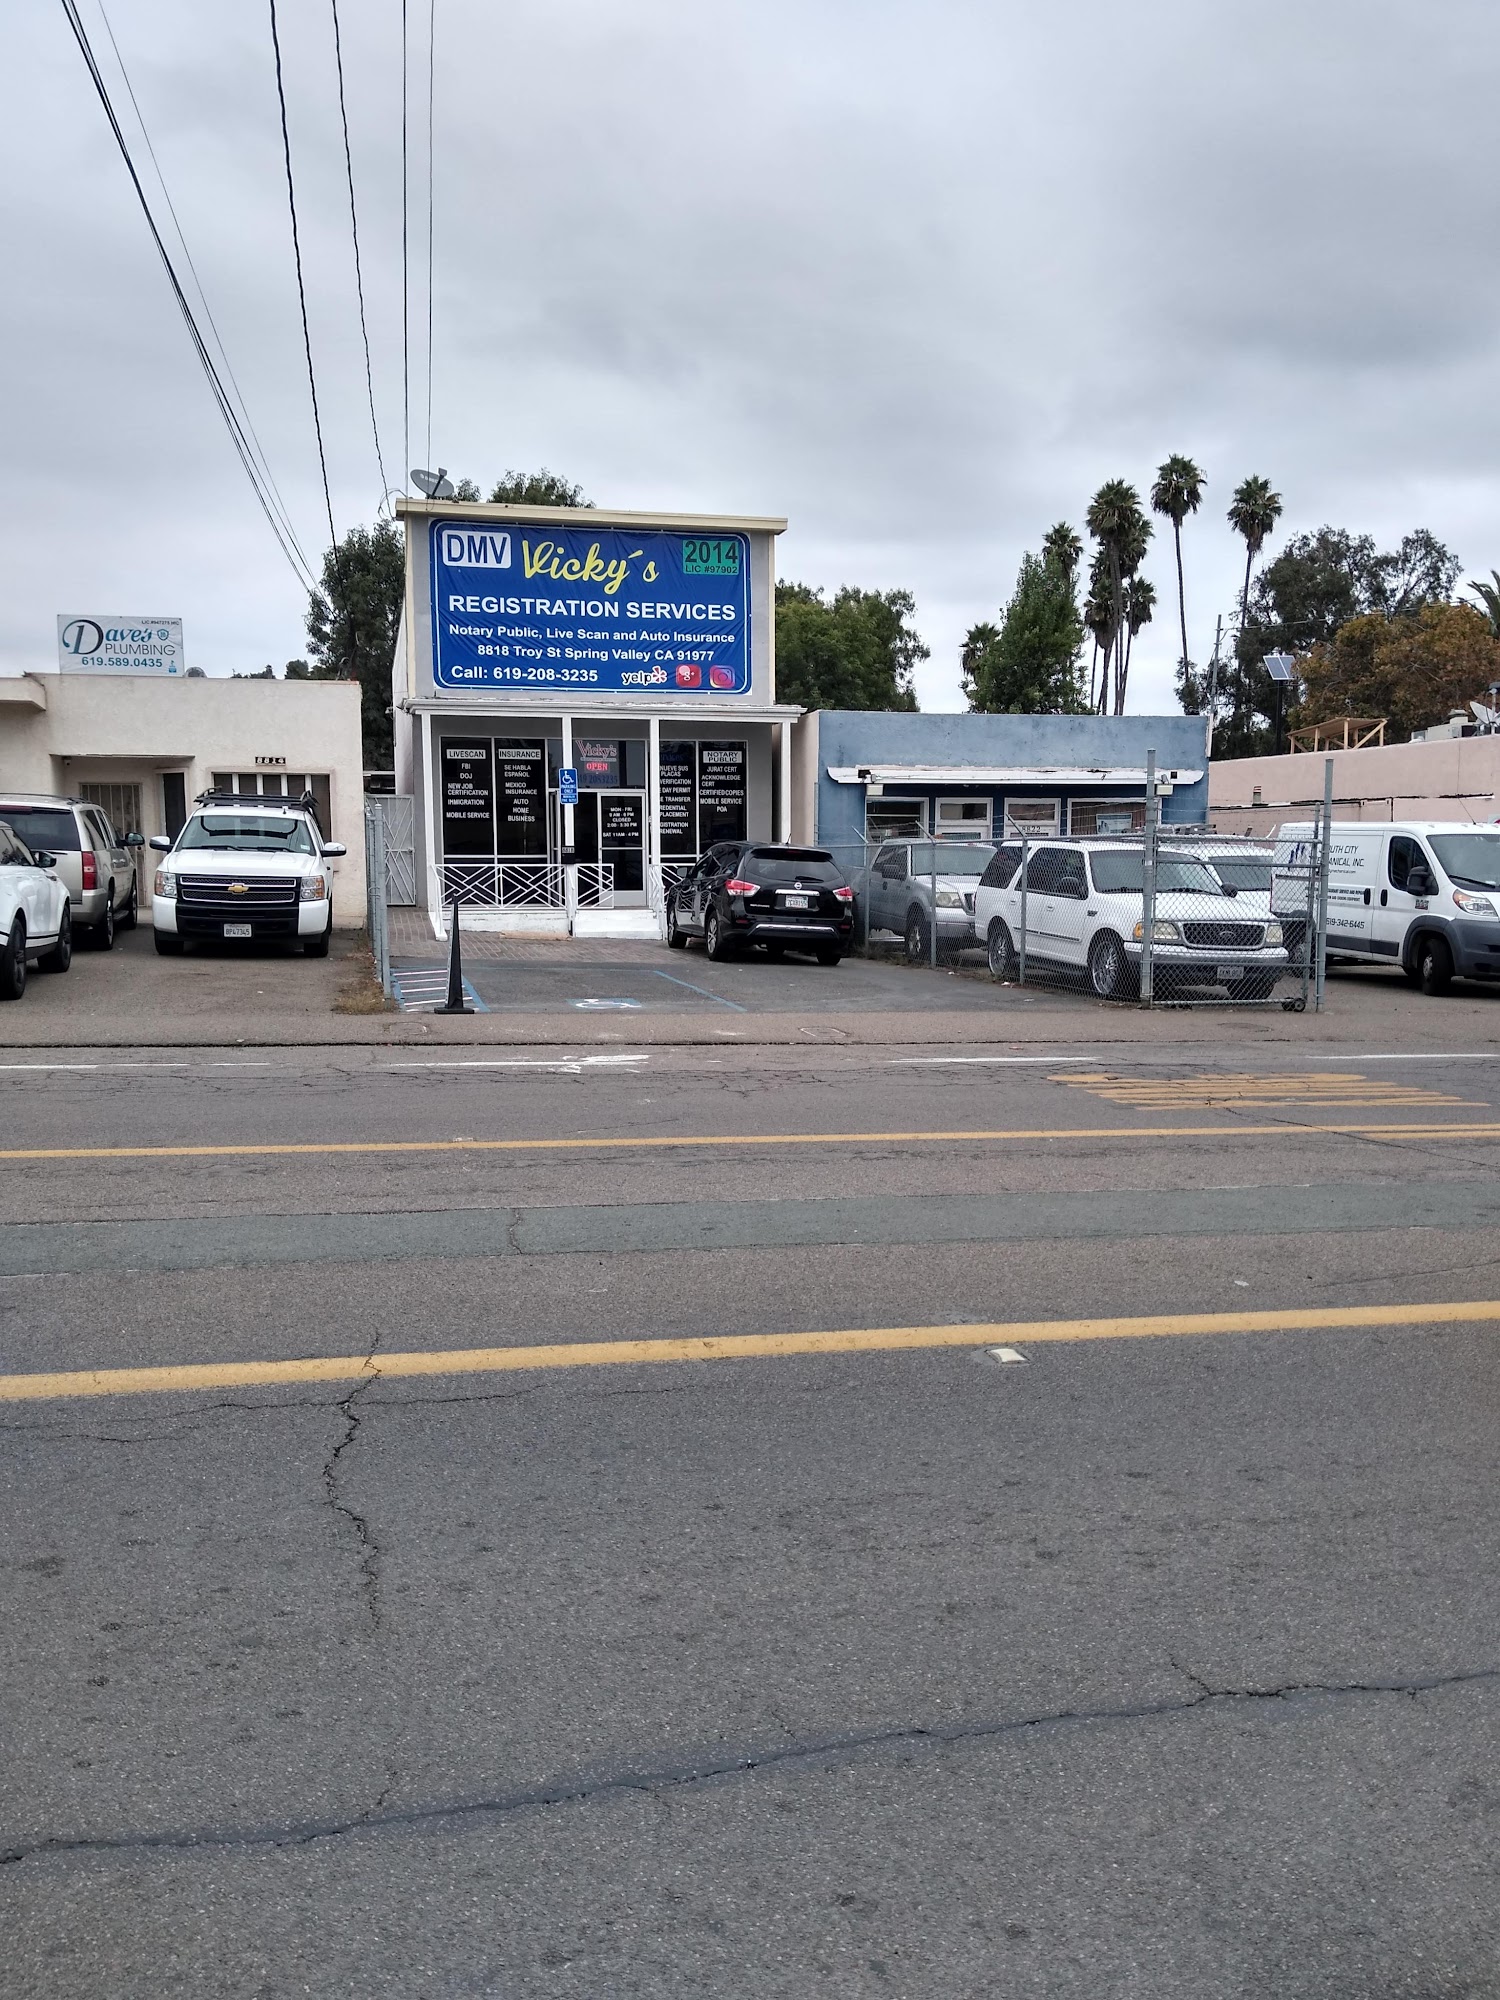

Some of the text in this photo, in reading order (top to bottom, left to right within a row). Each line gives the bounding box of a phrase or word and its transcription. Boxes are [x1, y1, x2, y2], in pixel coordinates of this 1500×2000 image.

[446, 533, 508, 565] DMV
[684, 540, 738, 564] 2014
[685, 564, 738, 574] LIC #97902
[449, 595, 736, 621] REGISTRATION SERVICES
[62, 619, 153, 655] Dave's
[449, 624, 735, 643] Notary Public, Live Scan and Auto Insurance
[105, 643, 176, 656] PLUMBING
[477, 645, 715, 662] 8818 Troy St Spring Valley CA 91977
[81, 657, 163, 668] 619.589.0435
[451, 666, 599, 682] Call: 619-208-3235
[622, 670, 653, 685] yelp
[449, 750, 484, 758] LIVESCAN
[499, 750, 540, 758] INSURANCE
[575, 740, 617, 759] Vicky's
[586, 762, 608, 771] OPEN
[1344, 845, 1359, 854] CITY
